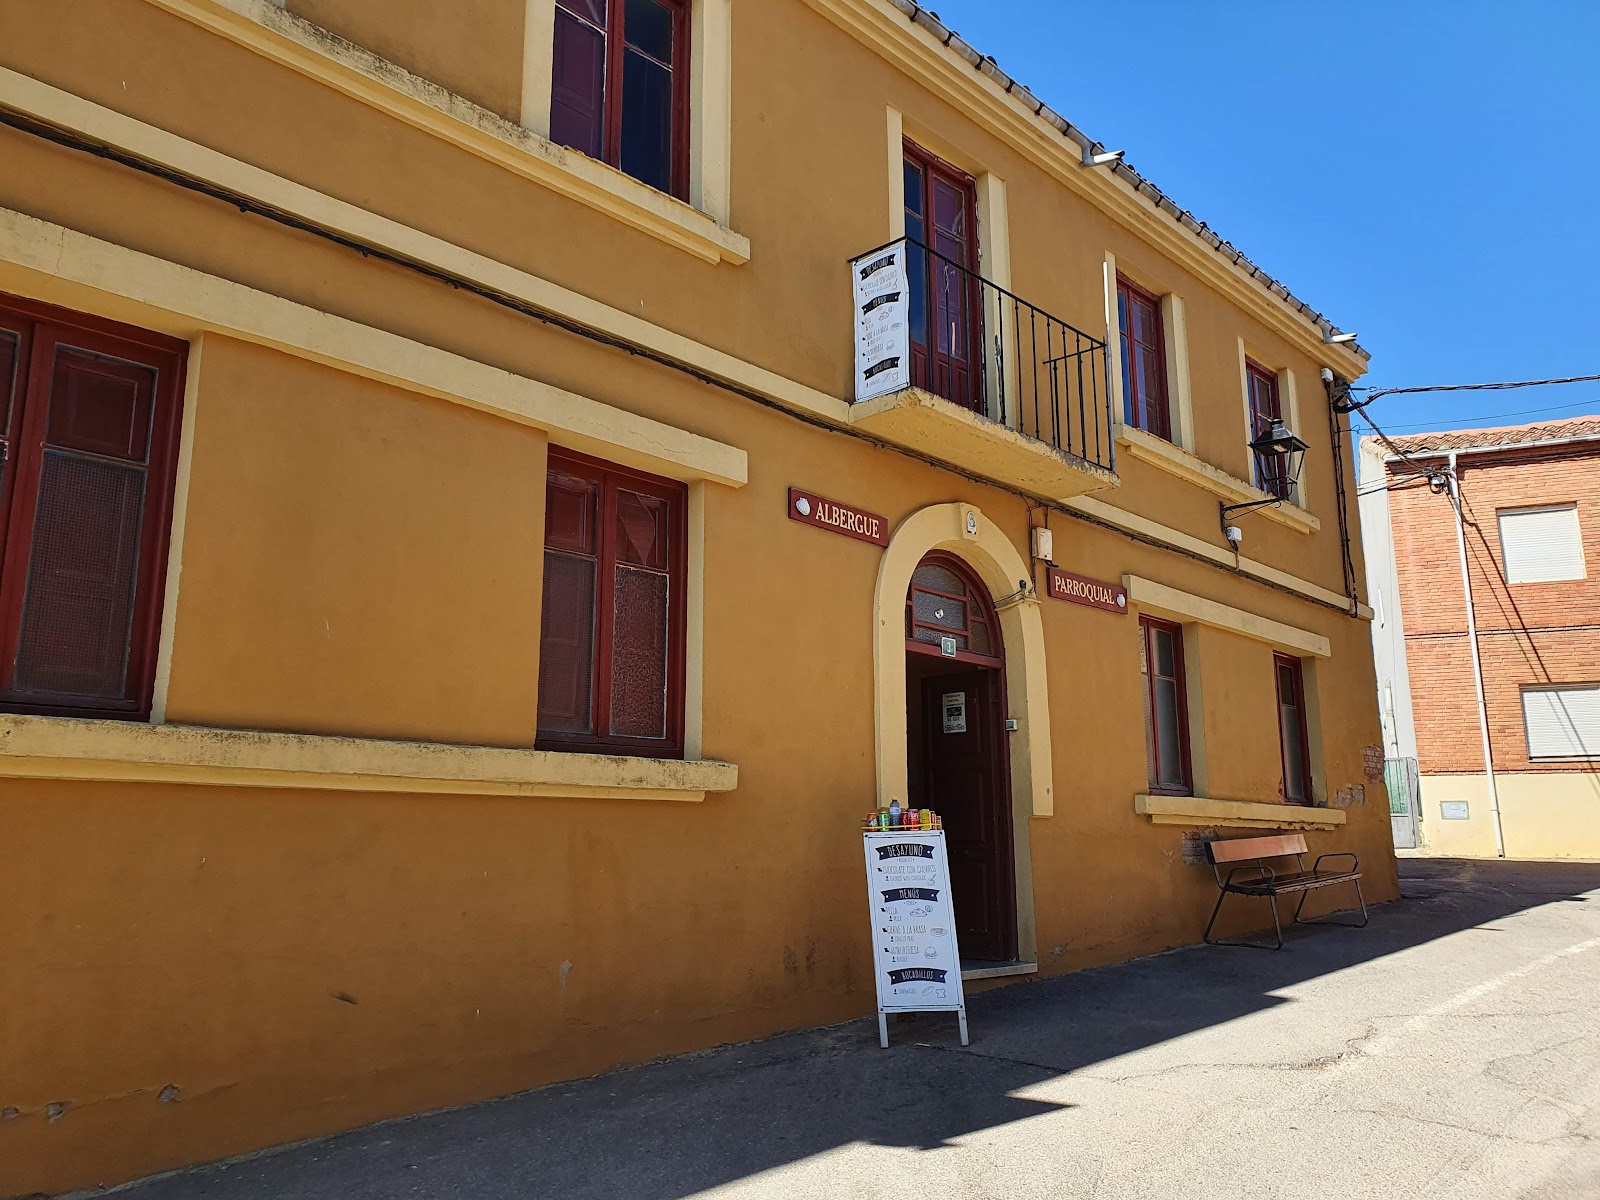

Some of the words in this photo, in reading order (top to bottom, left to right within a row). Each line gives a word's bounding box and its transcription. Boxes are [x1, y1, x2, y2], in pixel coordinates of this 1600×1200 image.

[815, 501, 880, 538] ALBERGUE
[1054, 575, 1115, 605] PARROQUIAL
[946, 641, 952, 653] 3
[886, 844, 923, 857] DESAYUNO
[898, 888, 920, 899] MENÚS
[886, 925, 901, 935] CARNE
[906, 925, 912, 934] LA
[900, 969, 934, 980] BOCADILLOS
